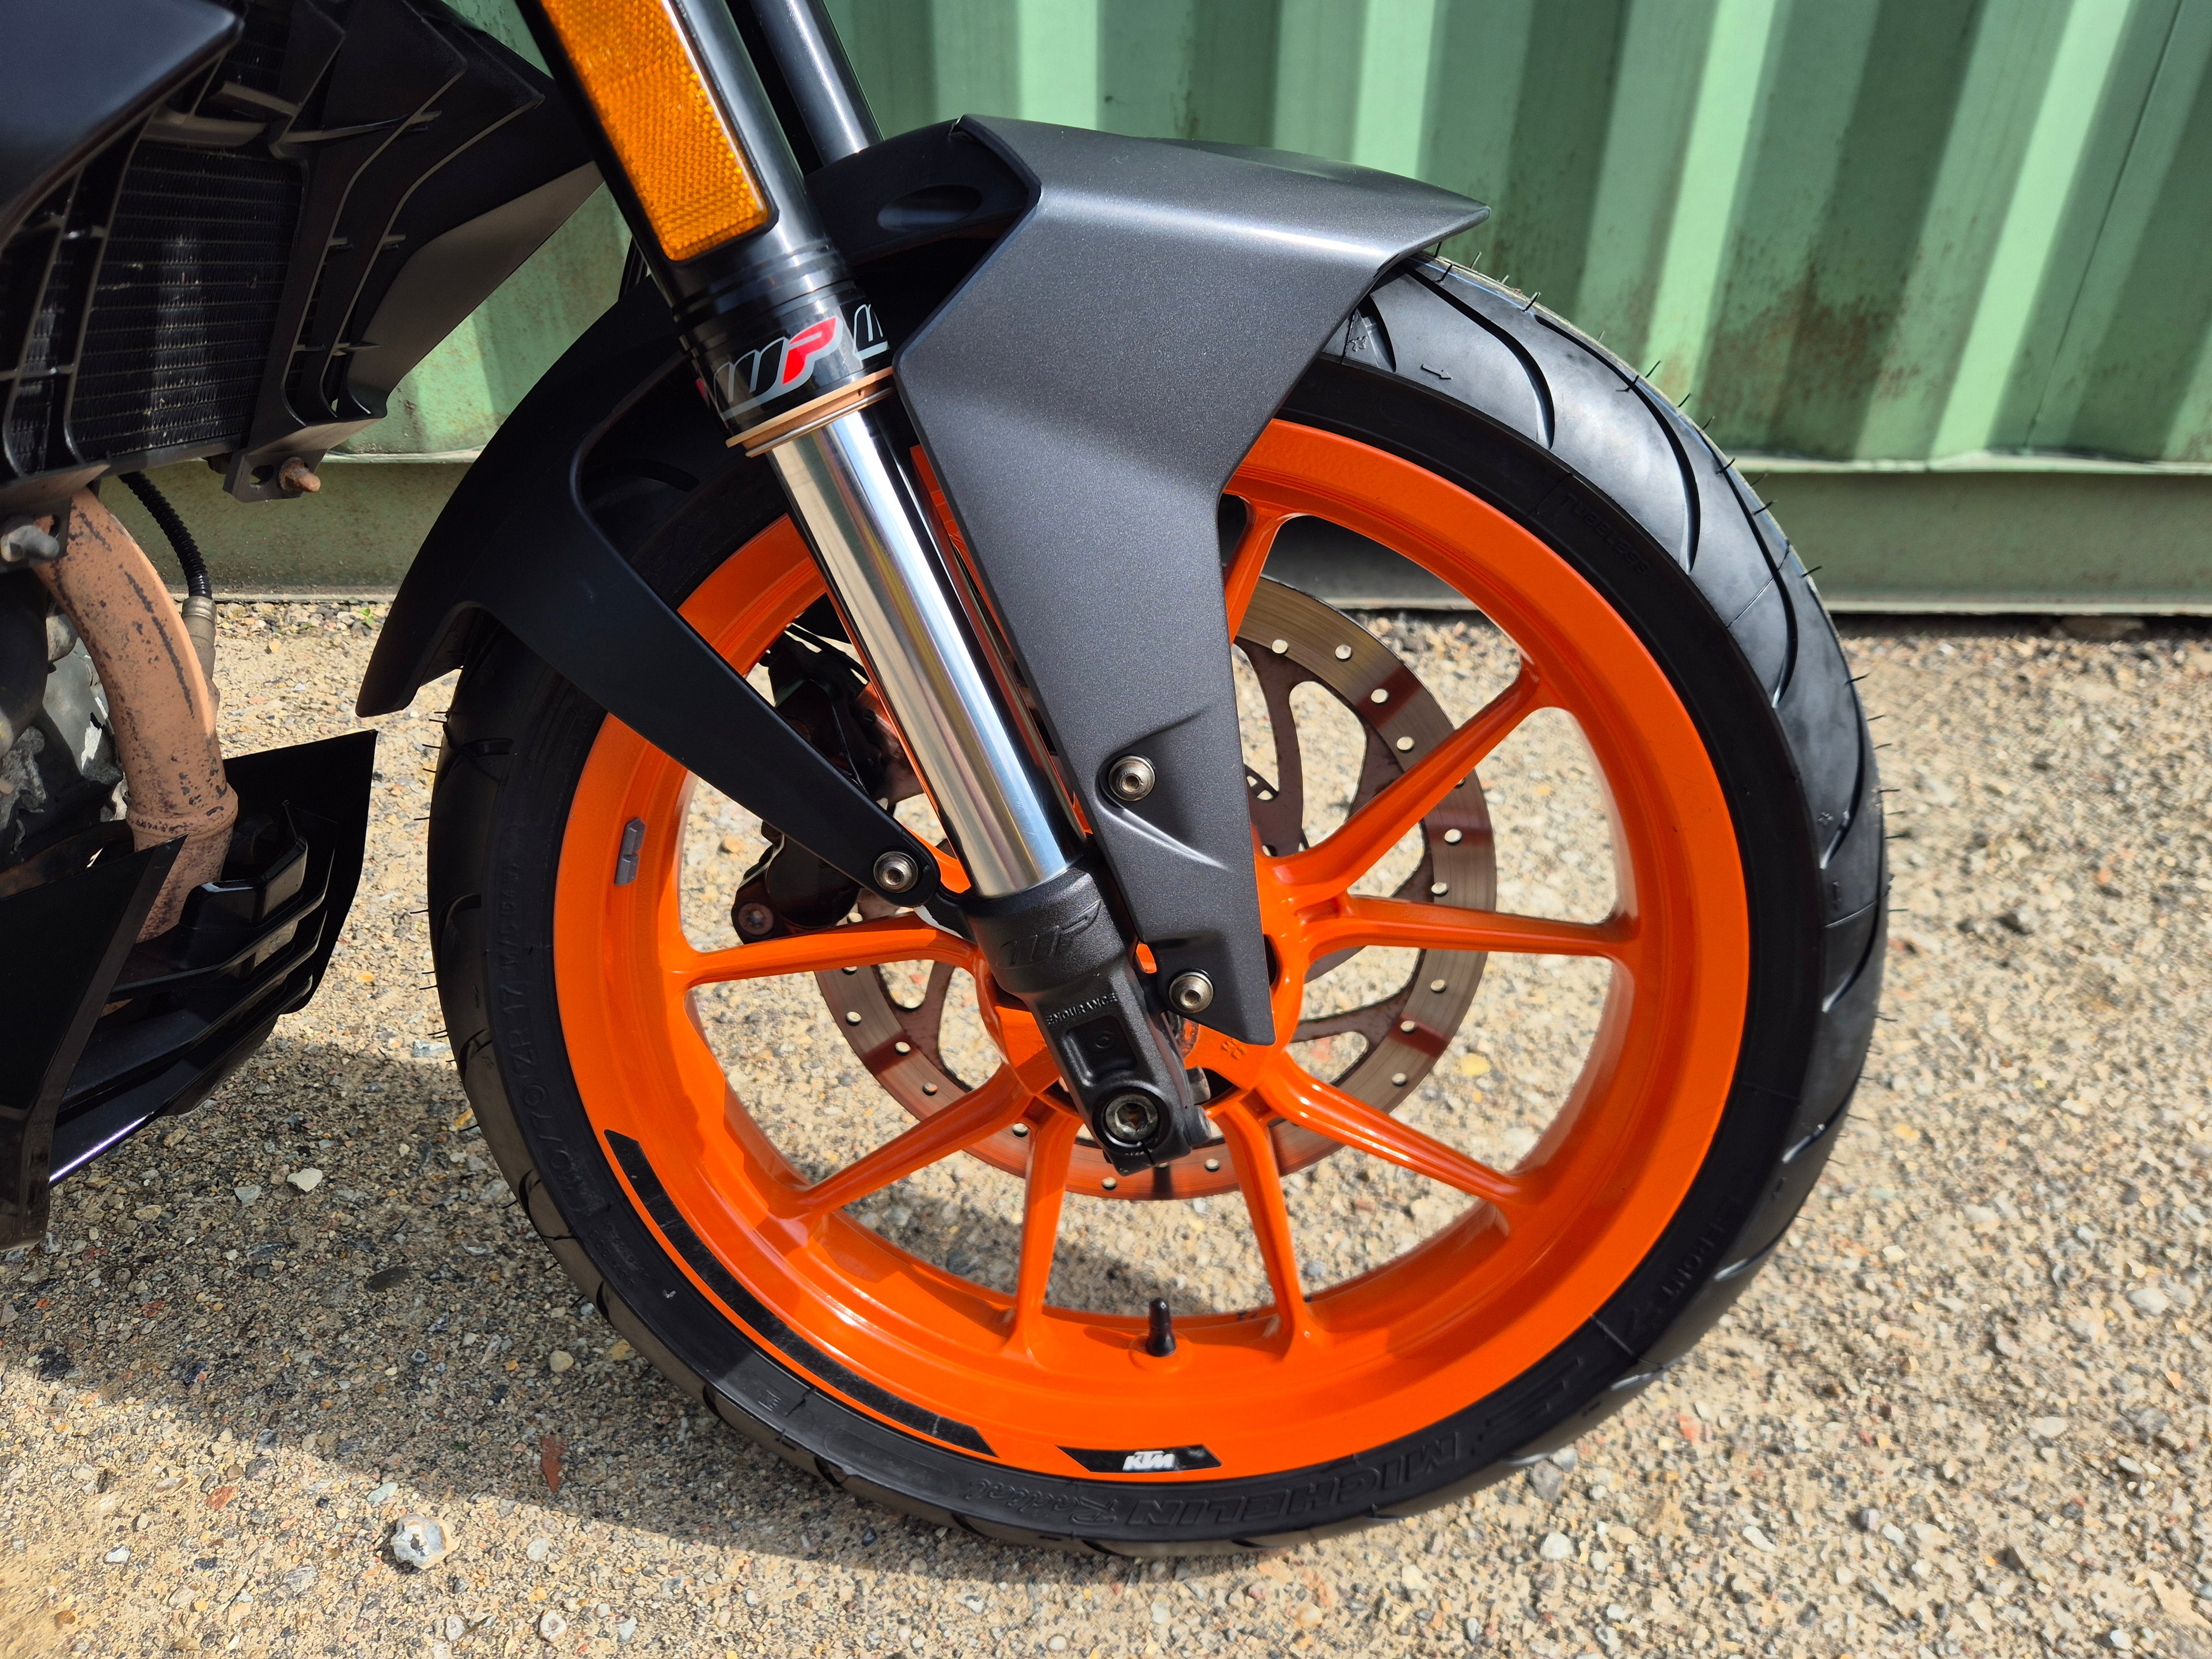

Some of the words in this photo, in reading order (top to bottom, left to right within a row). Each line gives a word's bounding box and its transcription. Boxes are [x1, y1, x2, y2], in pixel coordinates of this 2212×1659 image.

[1559, 494, 1652, 574] TUBELESS
[1046, 991, 1118, 1025] ENDURANCE
[1122, 1450, 1176, 1472] KTM
[1125, 1431, 1461, 1526] MICHELIN
